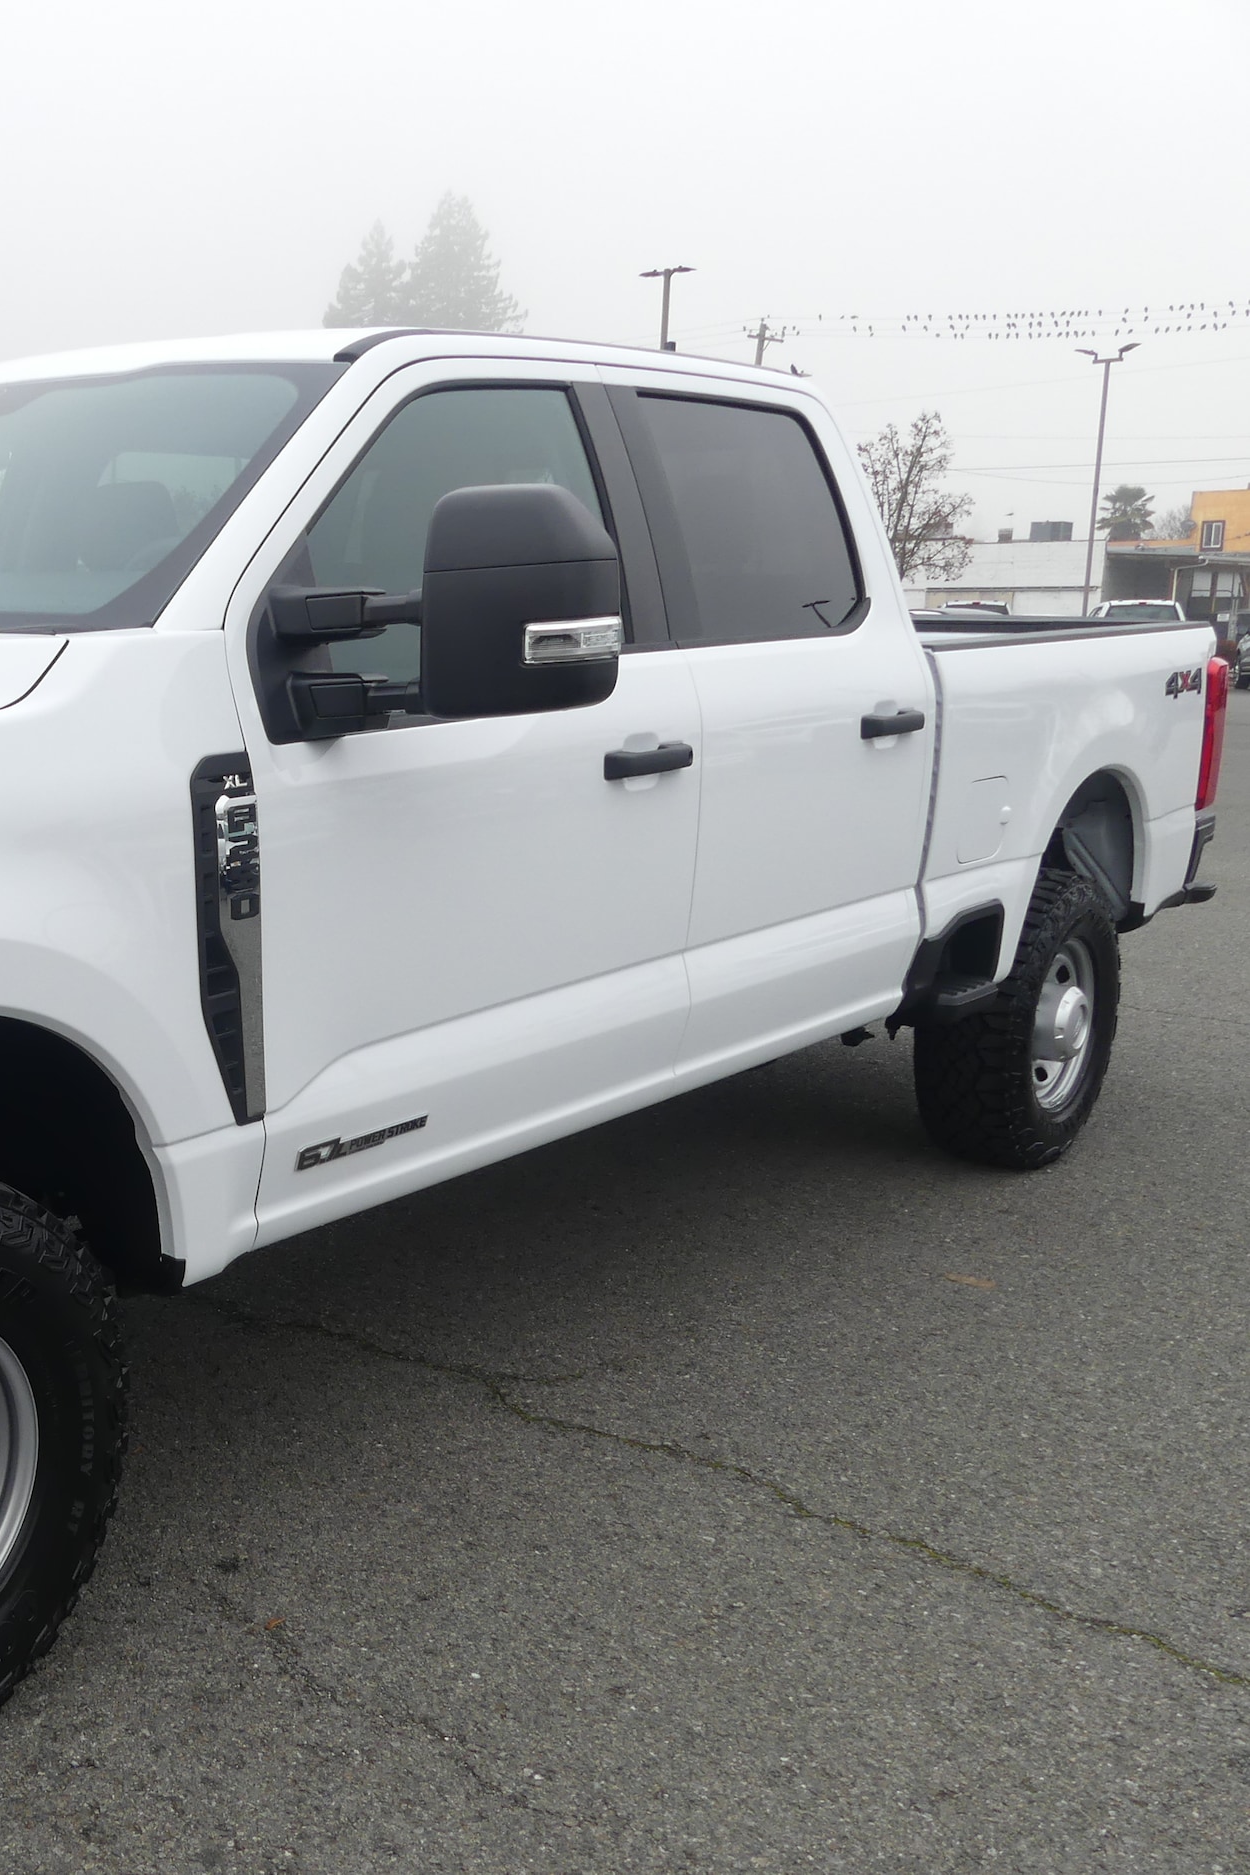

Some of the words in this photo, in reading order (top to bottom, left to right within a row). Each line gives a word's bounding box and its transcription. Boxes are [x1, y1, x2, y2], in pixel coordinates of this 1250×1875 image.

[223, 774, 247, 790] XL
[348, 1130, 386, 1151] POWER
[386, 1115, 429, 1138] STROKE
